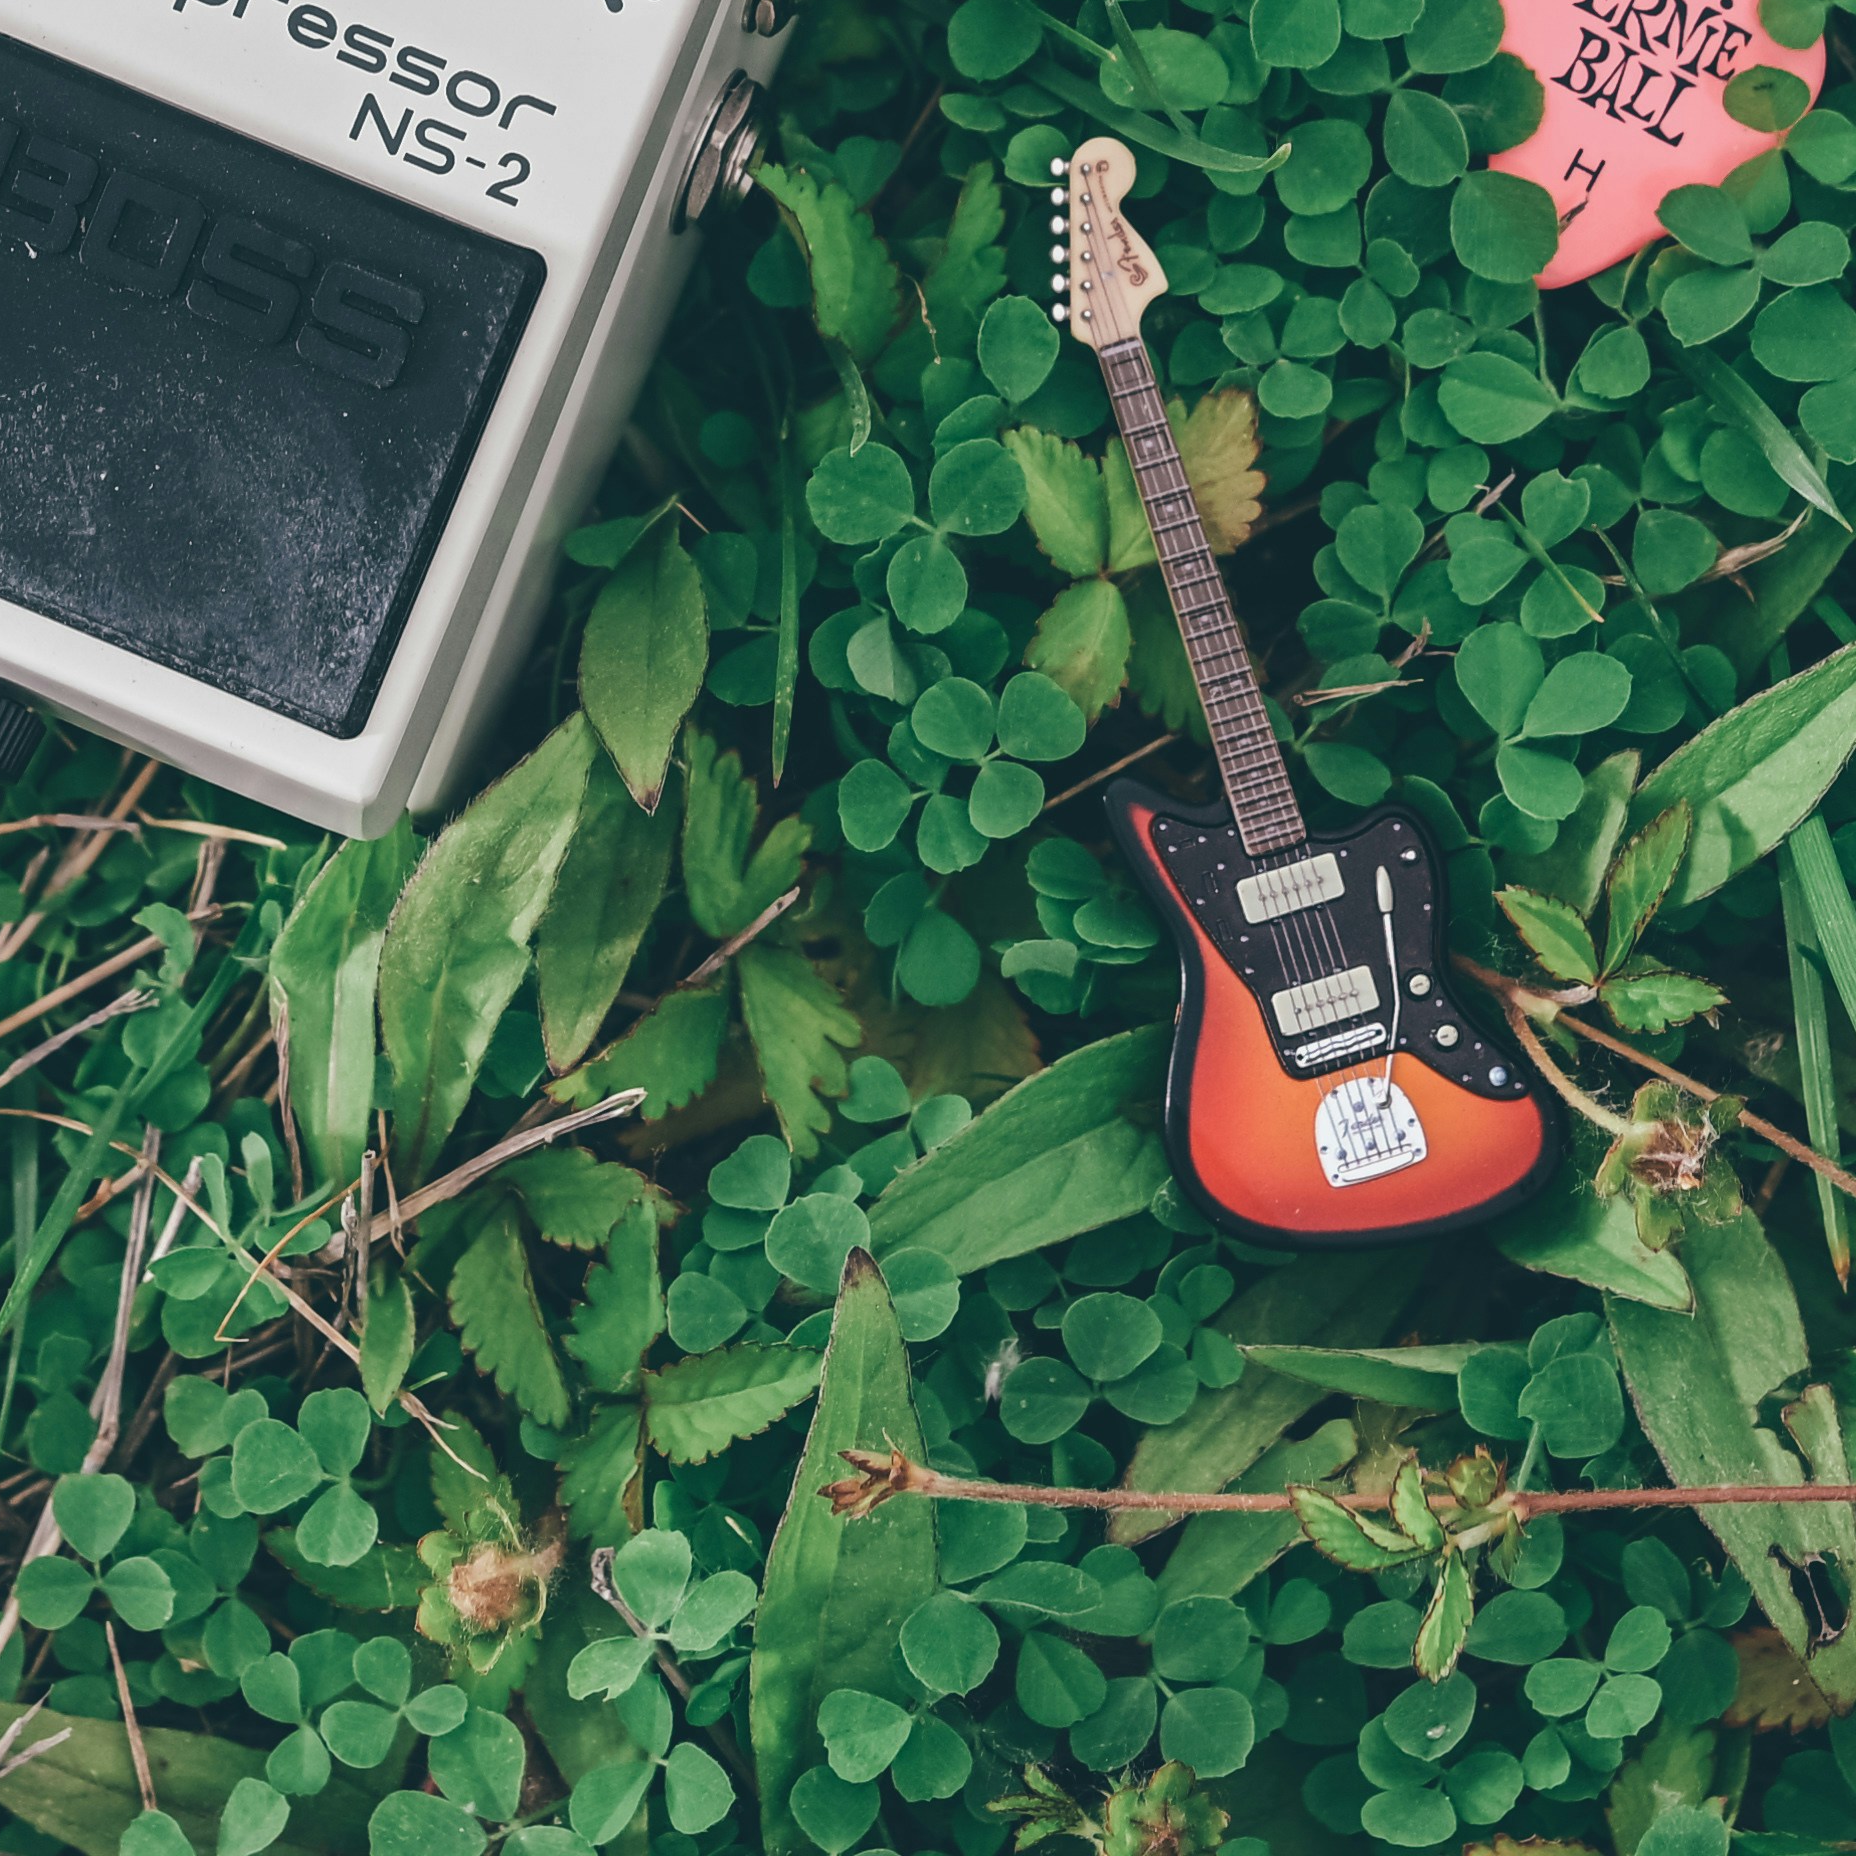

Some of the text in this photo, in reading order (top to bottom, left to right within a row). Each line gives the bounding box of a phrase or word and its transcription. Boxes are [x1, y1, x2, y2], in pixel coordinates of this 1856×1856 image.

[1550, 27, 1696, 147] BALL
[350, 94, 530, 206] NS-2
[1564, 148, 1605, 193] H
